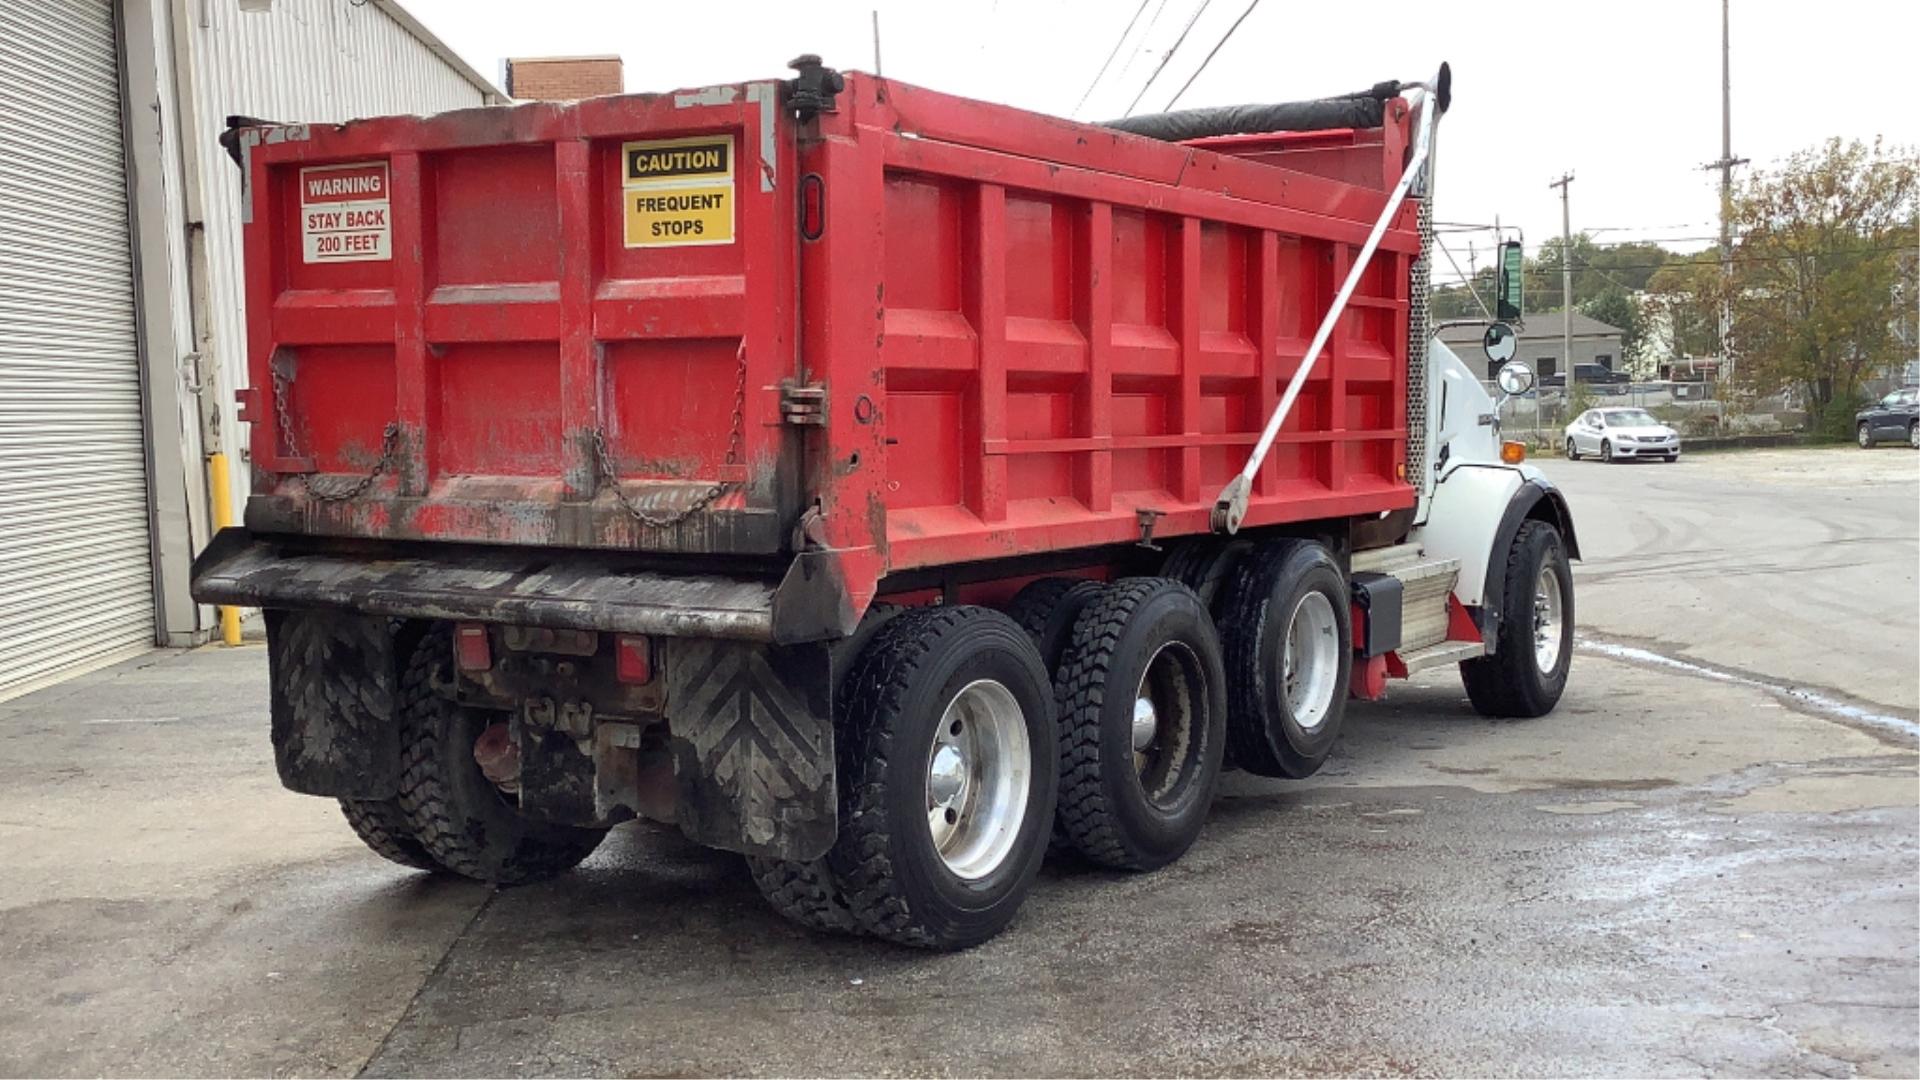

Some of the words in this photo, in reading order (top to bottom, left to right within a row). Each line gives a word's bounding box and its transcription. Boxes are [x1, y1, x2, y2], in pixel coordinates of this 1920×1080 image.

[636, 150, 719, 172] CAUTION
[308, 175, 381, 197] WARNING
[636, 194, 724, 213] FREQUENT
[308, 212, 341, 230] STAY
[346, 209, 385, 228] BACK
[651, 220, 703, 237] STOPS
[317, 236, 341, 252] 200
[345, 234, 380, 251] FEET
